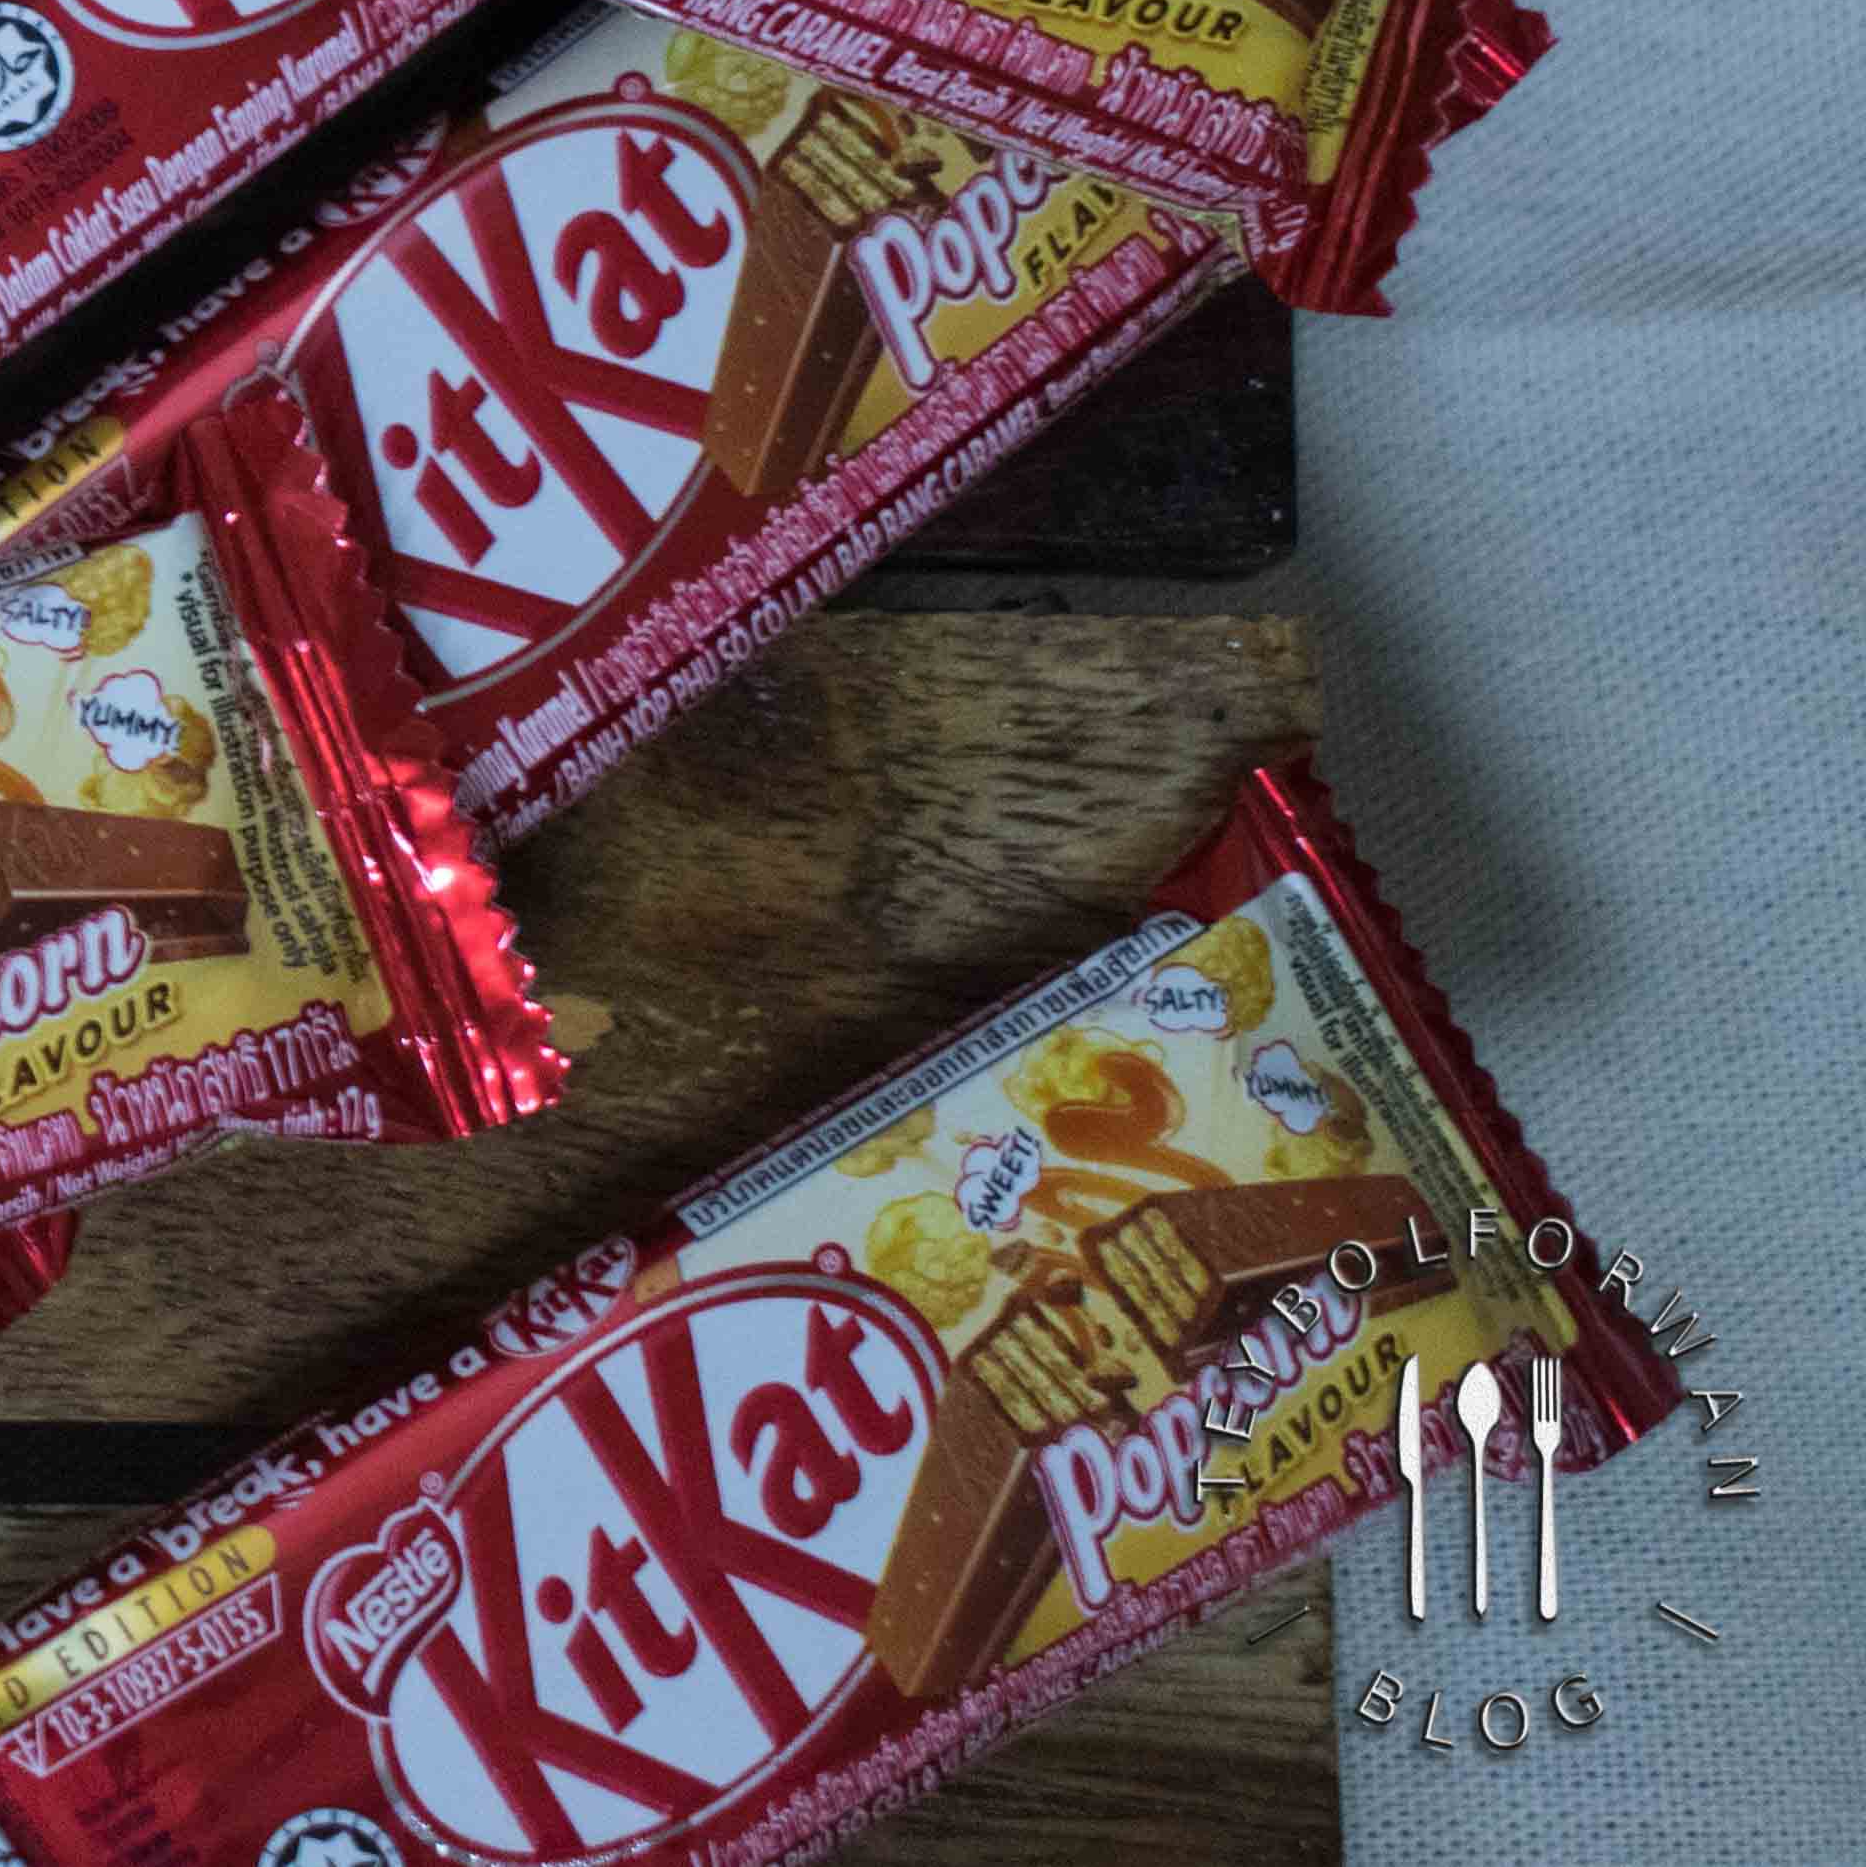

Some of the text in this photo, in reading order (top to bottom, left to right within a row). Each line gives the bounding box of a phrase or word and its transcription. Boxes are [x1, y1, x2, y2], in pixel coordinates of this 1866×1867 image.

[41, 198, 118, 272] Coklat
[92, 164, 164, 235] Susu
[139, 115, 236, 208] Dengan
[204, 65, 302, 159] Emping
[271, 10, 365, 97] Karamel
[855, 150, 1067, 387] Popc
[0, 596, 93, 639] SALTY!
[75, 697, 181, 748] YUMMY!
[175, 585, 211, 659] visual
[197, 656, 225, 694] for
[239, 821, 281, 921] purpose
[271, 915, 309, 970] only
[504, 670, 592, 794] Karamel
[1139, 982, 1229, 1015] SALTY!
[1288, 955, 1332, 1019] visual
[968, 1126, 1039, 1230] SWEET!
[104, 1549, 146, 1587] a
[321, 1377, 442, 1453] have
[446, 1349, 488, 1381] a
[45, 1538, 262, 1680] EDITION
[327, 1529, 451, 1670] Nestlé
[417, 1302, 916, 1862] KitKat
[45, 1606, 280, 1756] 10-3-10937-5-0155
